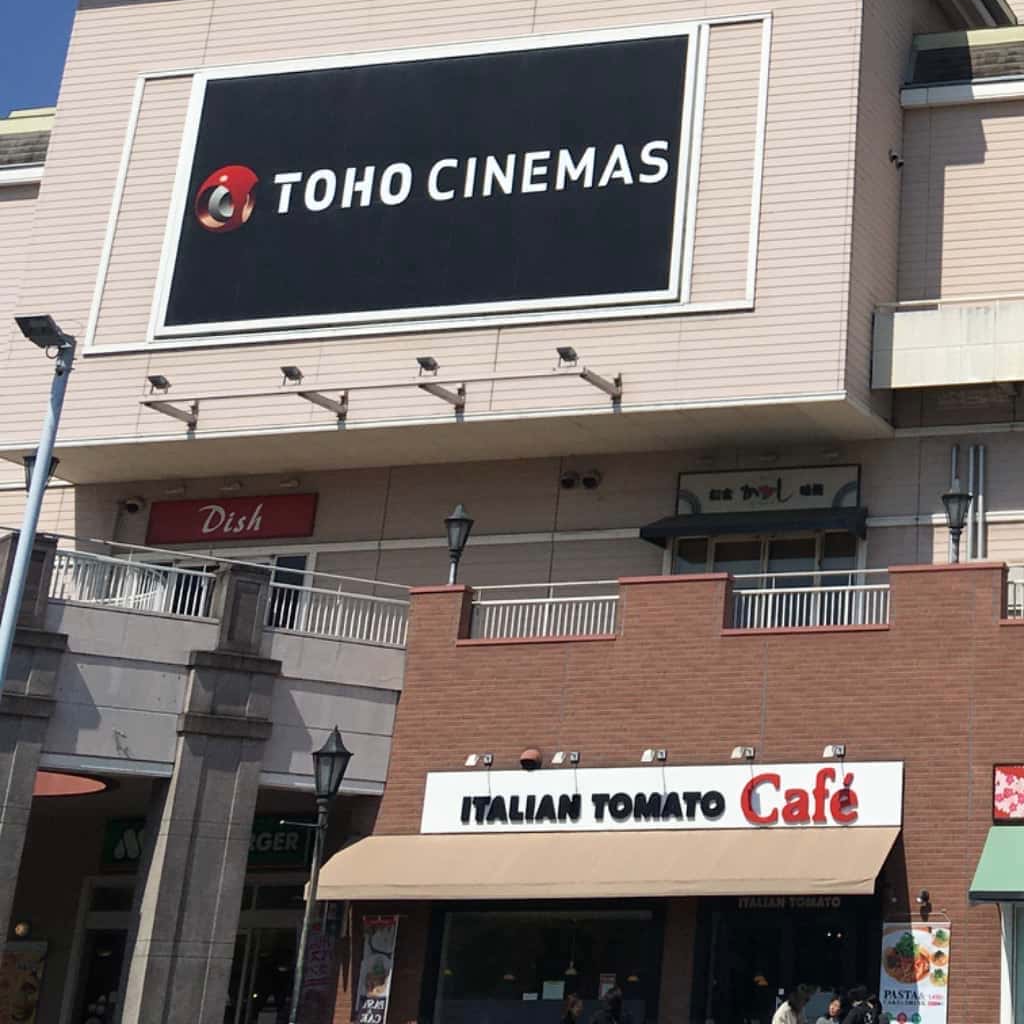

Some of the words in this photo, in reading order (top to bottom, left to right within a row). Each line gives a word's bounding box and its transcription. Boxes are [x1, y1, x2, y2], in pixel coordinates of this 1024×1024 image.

[274, 162, 413, 215] TOHO
[427, 139, 671, 203] CINEMAS
[199, 503, 264, 533] Dish
[460, 792, 583, 825] ITALIAN
[591, 789, 727, 824] TOMATO
[740, 767, 859, 826] Café
